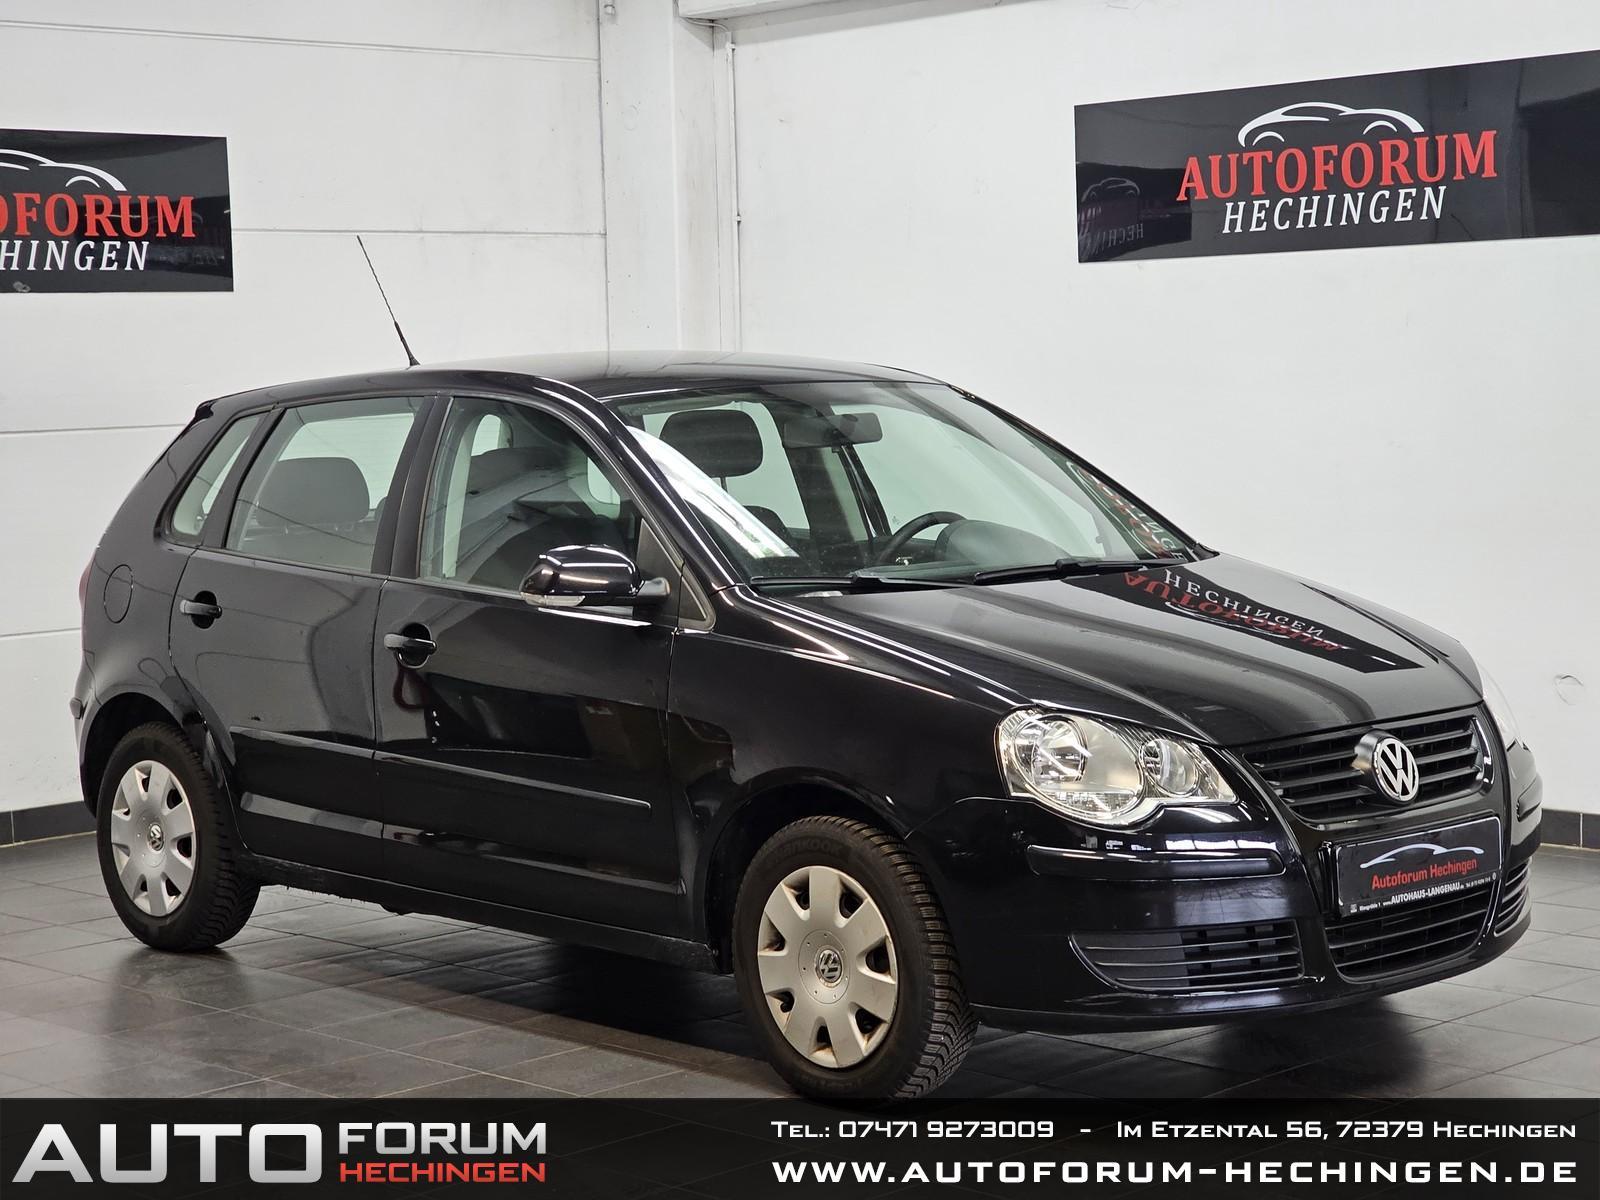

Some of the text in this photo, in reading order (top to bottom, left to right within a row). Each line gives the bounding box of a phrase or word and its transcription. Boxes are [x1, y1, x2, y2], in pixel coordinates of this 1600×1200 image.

[1177, 129, 1498, 202] AUTOFORUM
[1222, 186, 1447, 234] HECHINGEN
[0, 239, 150, 271] HINGEN
[1371, 858, 1477, 890] Autoforum Hechingen
